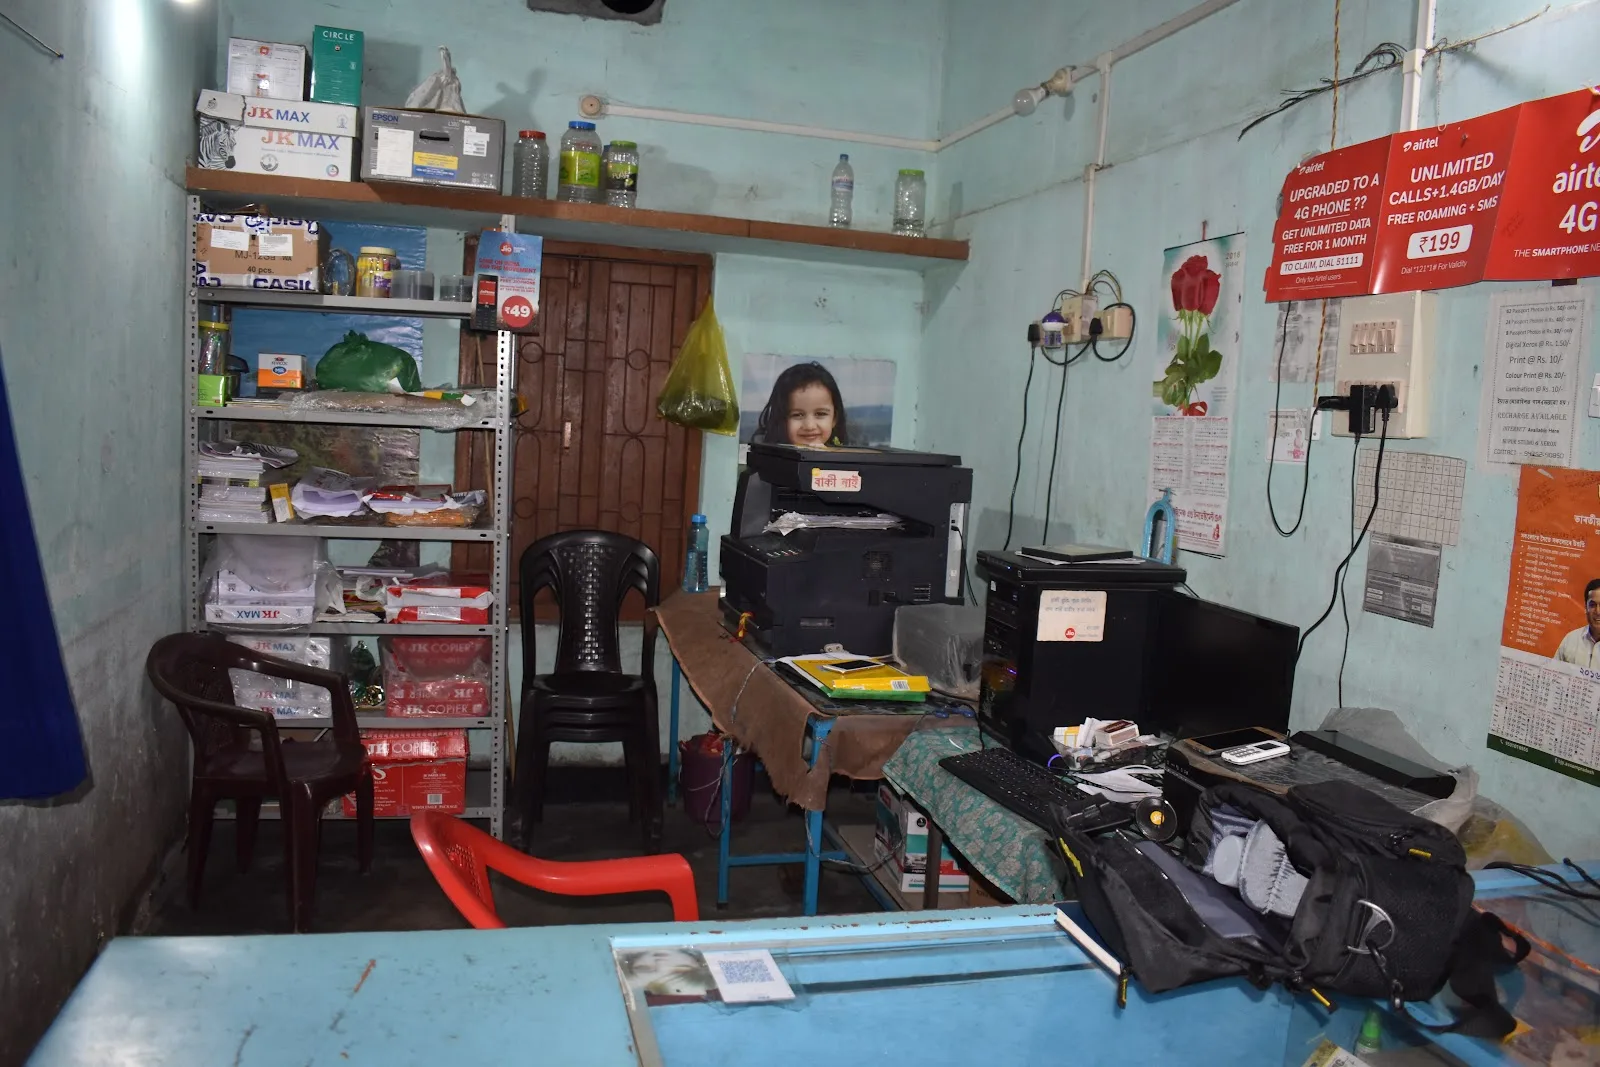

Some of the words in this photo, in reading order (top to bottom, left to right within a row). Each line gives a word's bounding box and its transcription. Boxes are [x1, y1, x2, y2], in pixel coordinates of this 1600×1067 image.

[322, 30, 355, 41] CIRCLE
[247, 106, 274, 120] JK
[276, 109, 310, 123] MAX
[372, 113, 399, 122] EPSON
[261, 130, 295, 146] JK
[297, 132, 340, 150] MAX
[1412, 136, 1439, 151] airtel
[1305, 161, 1325, 174] airtel
[1411, 152, 1494, 183] UNLIMITED
[1290, 179, 1350, 203] UPGRADED
[1353, 174, 1369, 190] TO
[1370, 172, 1380, 187] A
[1389, 170, 1505, 205] CALLS+1.4GB/DAY
[1294, 207, 1309, 220] 4G
[1311, 198, 1352, 218] PHONE
[1354, 195, 1368, 210] ??
[1387, 212, 1416, 225] FREE
[1416, 203, 1467, 223] ROAMING
[1477, 195, 1499, 212] SMS
[1559, 201, 1598, 234] 4G
[1282, 228, 1300, 241] GET
[1300, 220, 1348, 238] UNLIMITED
[1349, 217, 1371, 230] DATA
[1283, 241, 1304, 255] FREE
[1305, 239, 1323, 252] FOR
[1325, 239, 1331, 250] 1
[1332, 233, 1367, 249] MONTH
[1419, 231, 1460, 253] ₹199
[500, 245, 512, 253] Jio
[1514, 249, 1531, 258] THE
[1532, 244, 1589, 257] SMARTPHONE
[1284, 263, 1293, 272] TO
[1294, 260, 1318, 271] CLAIM,
[1318, 257, 1334, 268] DIAL
[1336, 255, 1359, 266] 51111
[1401, 266, 1413, 275] Dial
[1437, 263, 1448, 271] For
[1448, 259, 1468, 270] Validity
[258, 267, 274, 275] pcs.
[1295, 276, 1306, 286] Only
[1306, 275, 1314, 283] for
[1314, 274, 1328, 282] Airtel
[1509, 356, 1526, 364] Print
[1527, 355, 1536, 365] @
[1536, 355, 1547, 364] Rs.
[1549, 355, 1564, 364] 10/-
[1537, 372, 1544, 380] @
[1497, 412, 1530, 420] RECHARGE
[1530, 413, 1567, 421] AVAILABLE
[237, 610, 260, 618] MAX
[262, 610, 280, 619] JK
[255, 642, 272, 650] JK
[273, 643, 296, 651] MAX
[408, 643, 429, 653] JK
[431, 643, 470, 653] COPIER
[275, 691, 298, 699] MAX
[454, 688, 474, 698] JK
[276, 707, 300, 715] MAX
[403, 705, 424, 714] JK
[427, 704, 468, 714] COPIER
[367, 742, 390, 755] JK
[392, 741, 438, 755] COPIER
